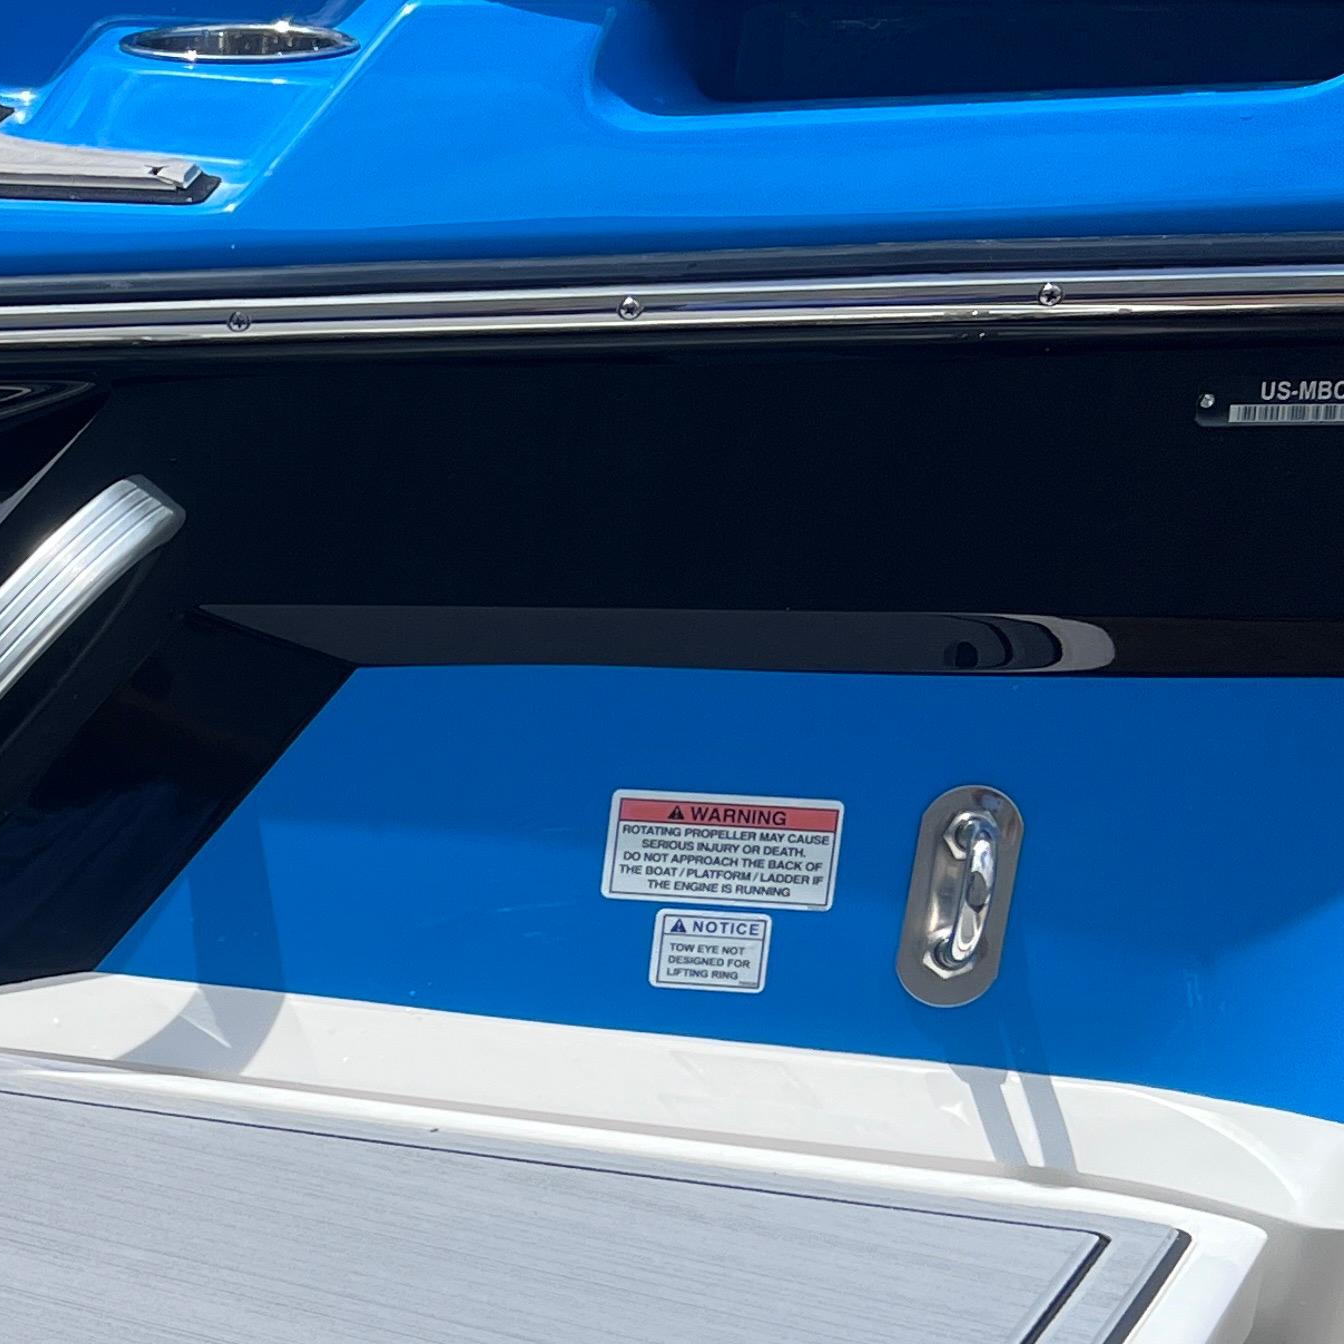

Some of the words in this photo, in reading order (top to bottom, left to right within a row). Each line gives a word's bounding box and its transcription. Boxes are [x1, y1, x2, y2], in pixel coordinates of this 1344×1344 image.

[691, 806, 786, 825] WARNING
[622, 824, 681, 837] ROTATING
[684, 828, 756, 841] PROPELLER
[759, 832, 785, 843] MAY
[788, 833, 830, 846] CAUSE
[642, 839, 694, 851] SERIOUS
[697, 842, 740, 853] INJURY
[742, 845, 760, 855] OR
[763, 846, 806, 858] DEATH.
[623, 851, 641, 861] DO
[644, 853, 669, 862] NOT
[670, 854, 738, 866] APPROACH
[741, 858, 765, 869] THE
[768, 860, 802, 871] BACK
[805, 862, 823, 872] OF
[619, 864, 643, 875] THE
[645, 866, 678, 877] BOAT
[686, 868, 751, 881] PLATFORM
[760, 873, 810, 885] LADDER
[812, 876, 824, 885] IF
[647, 879, 671, 890] THE
[674, 881, 718, 893] ENGINE
[721, 883, 733, 894] IS
[735, 884, 791, 897] RUNNING
[692, 920, 760, 936] NOTICE
[670, 942, 695, 953] TOW
[697, 944, 719, 954] EYE
[721, 946, 745, 956] NOT
[668, 955, 724, 967] DESIGNED
[727, 959, 751, 969] FOR
[666, 967, 709, 979] LIFTING
[711, 970, 738, 980] RING
